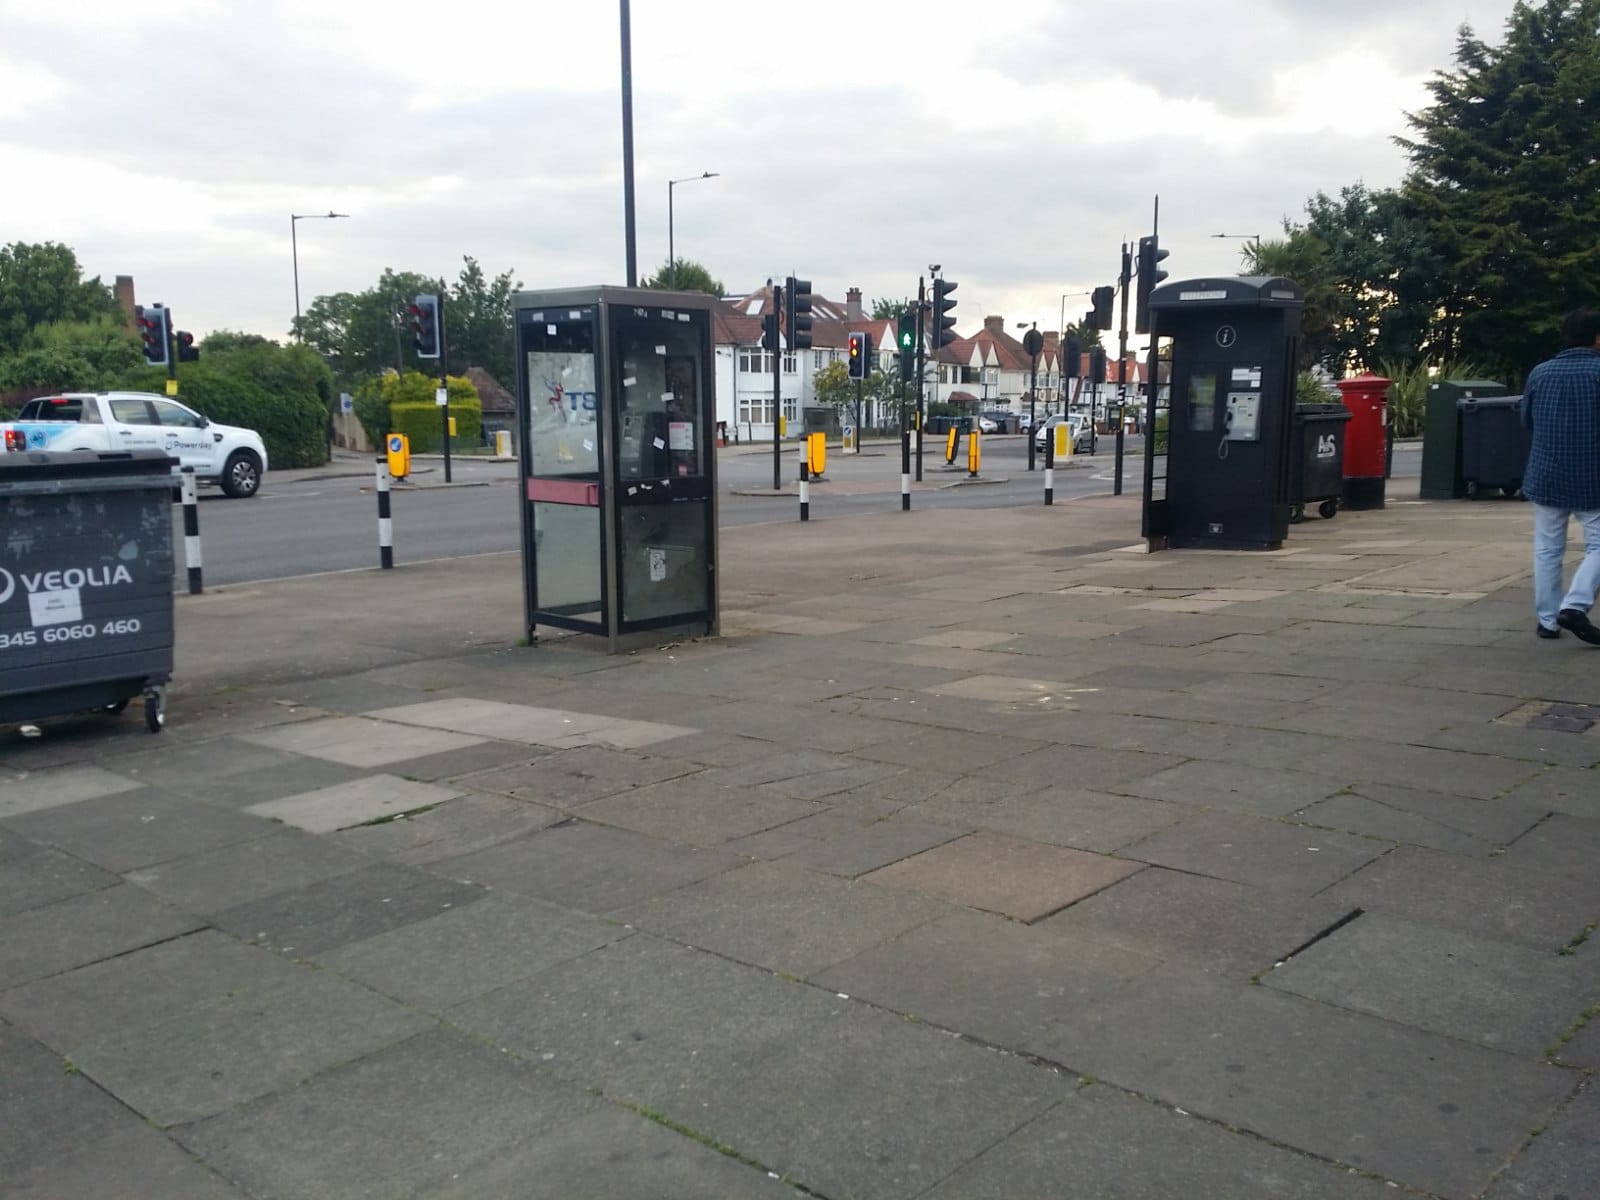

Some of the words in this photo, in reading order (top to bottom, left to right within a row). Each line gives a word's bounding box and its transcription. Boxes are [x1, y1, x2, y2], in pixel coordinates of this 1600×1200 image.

[174, 440, 212, 449] Powerday
[20, 564, 133, 592] VEOLIA
[43, 624, 96, 642] 6060
[102, 618, 141, 635] 460
